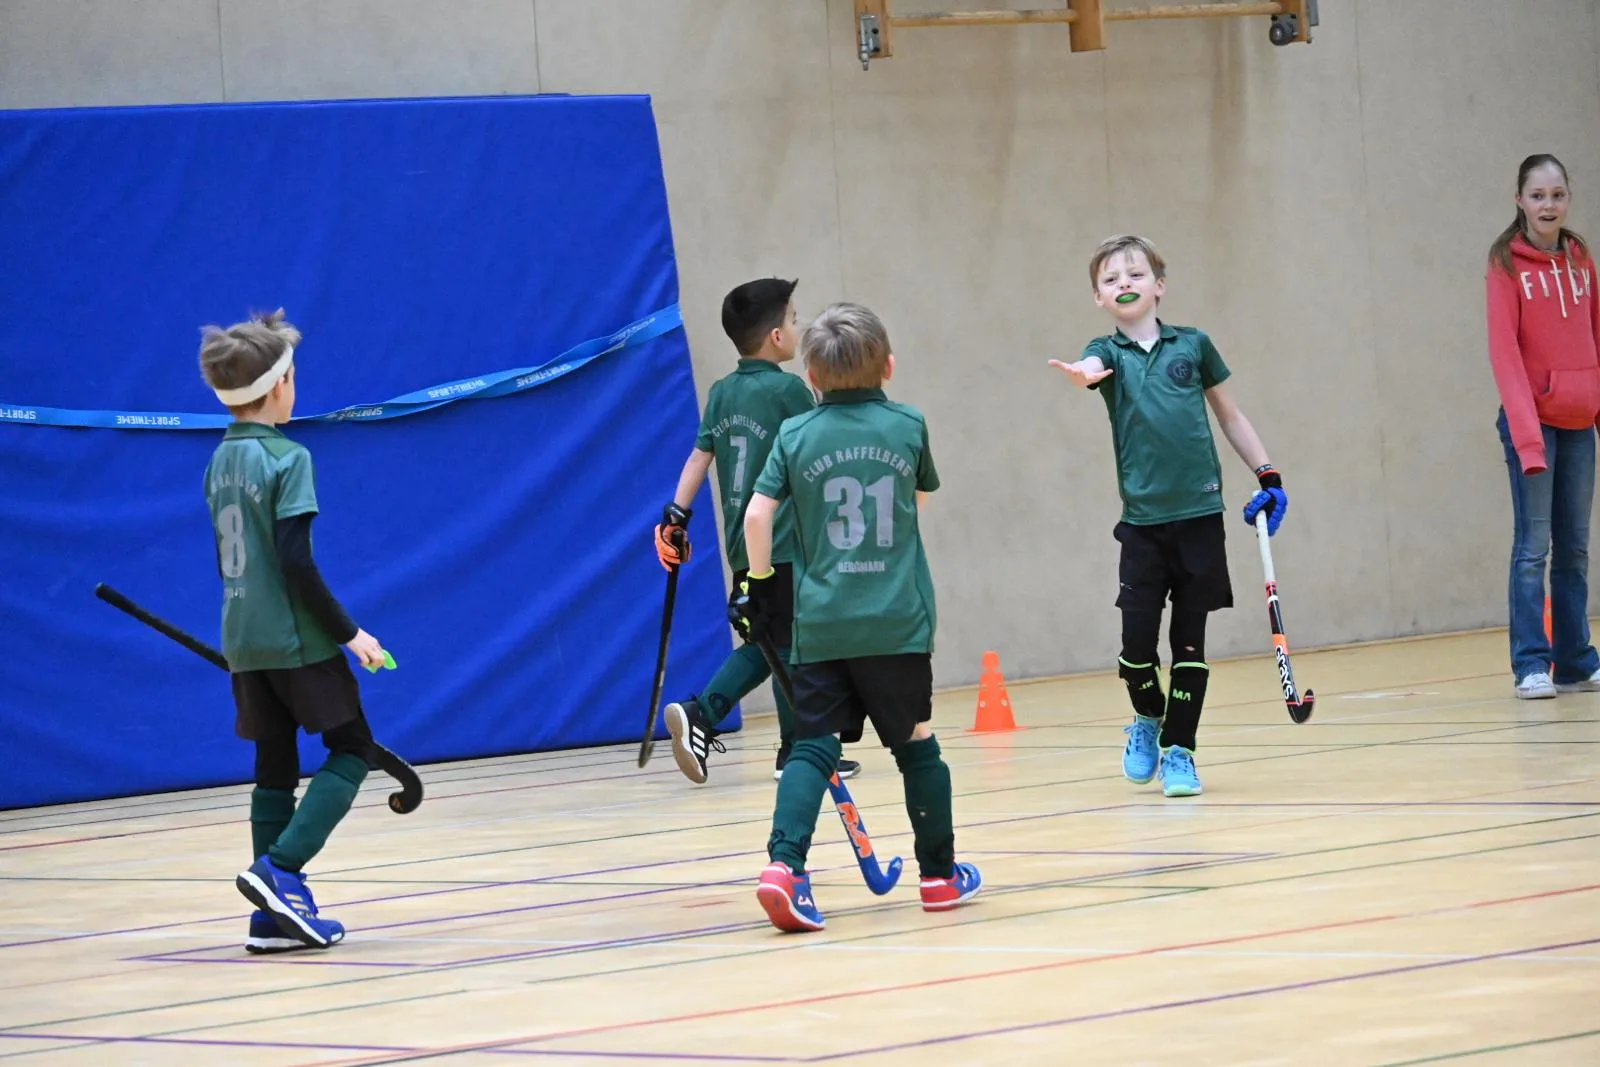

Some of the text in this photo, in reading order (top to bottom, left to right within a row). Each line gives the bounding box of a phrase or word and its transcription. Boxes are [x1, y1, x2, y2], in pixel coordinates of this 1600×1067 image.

[730, 435, 747, 492] 7
[803, 446, 913, 482] CLUB RAFFELBERG
[218, 504, 246, 578] 8
[824, 475, 895, 550] 31
